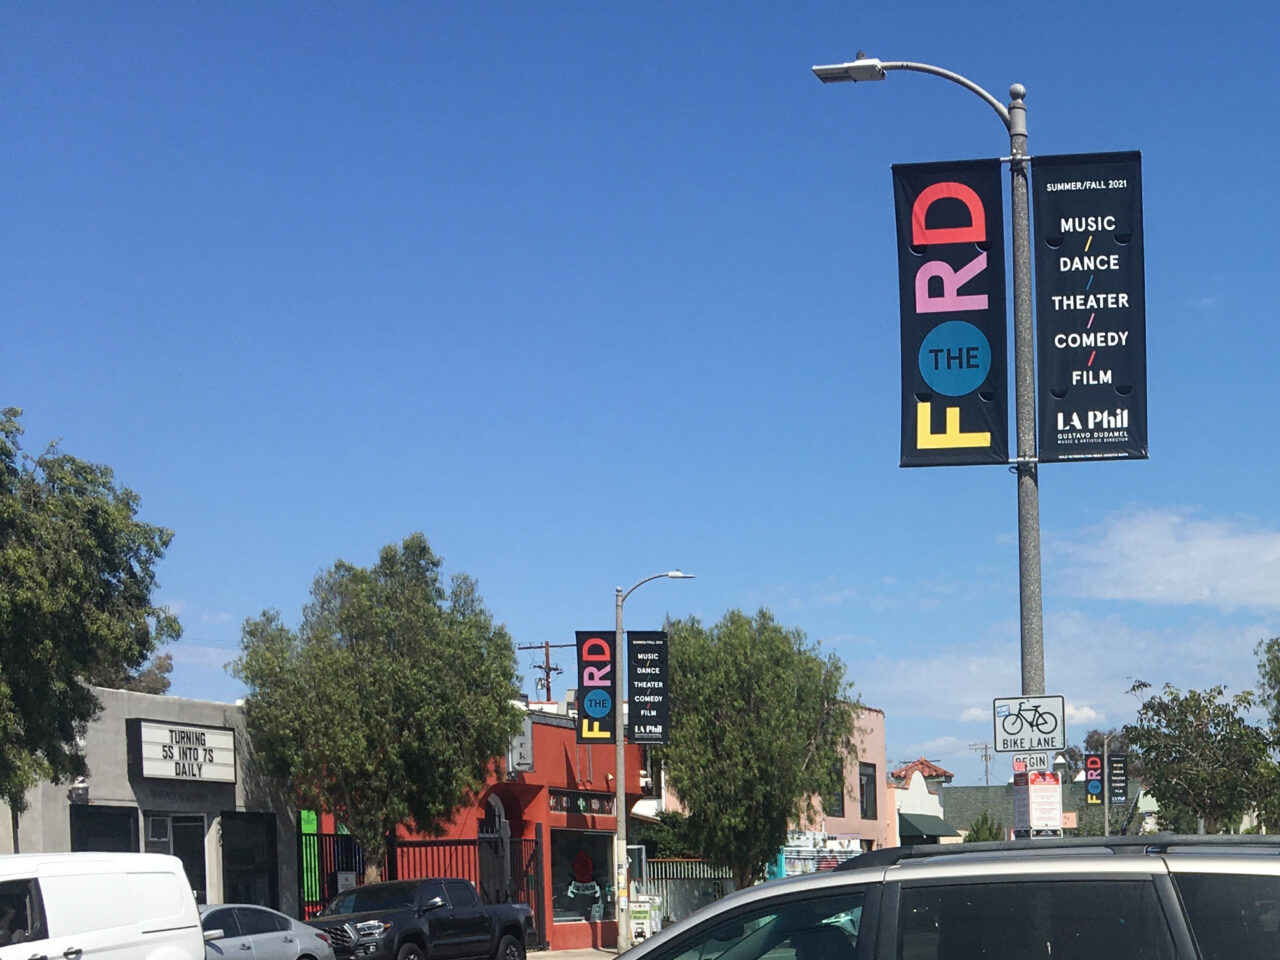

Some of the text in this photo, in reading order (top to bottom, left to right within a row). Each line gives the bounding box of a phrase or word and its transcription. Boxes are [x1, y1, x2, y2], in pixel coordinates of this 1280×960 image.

[1046, 180, 1127, 191] SUMMER/FALL 2021
[1060, 215, 1116, 233] MUSIC
[1059, 255, 1119, 272] DANCE
[1051, 293, 1129, 311] THEATER
[1054, 331, 1129, 349] COMEDY
[928, 346, 980, 370] THE
[1072, 370, 1112, 385] FILM
[1057, 408, 1128, 431] LA Phil
[1057, 430, 1128, 440] GUSTAVO DUDAMEL
[588, 698, 607, 709] THE
[634, 695, 663, 703] COMEDY
[168, 730, 206, 746] TURNING
[1002, 736, 1057, 749] BIKE LANE
[162, 745, 214, 763] 5S INTO 7S
[174, 762, 203, 777] DAILY
